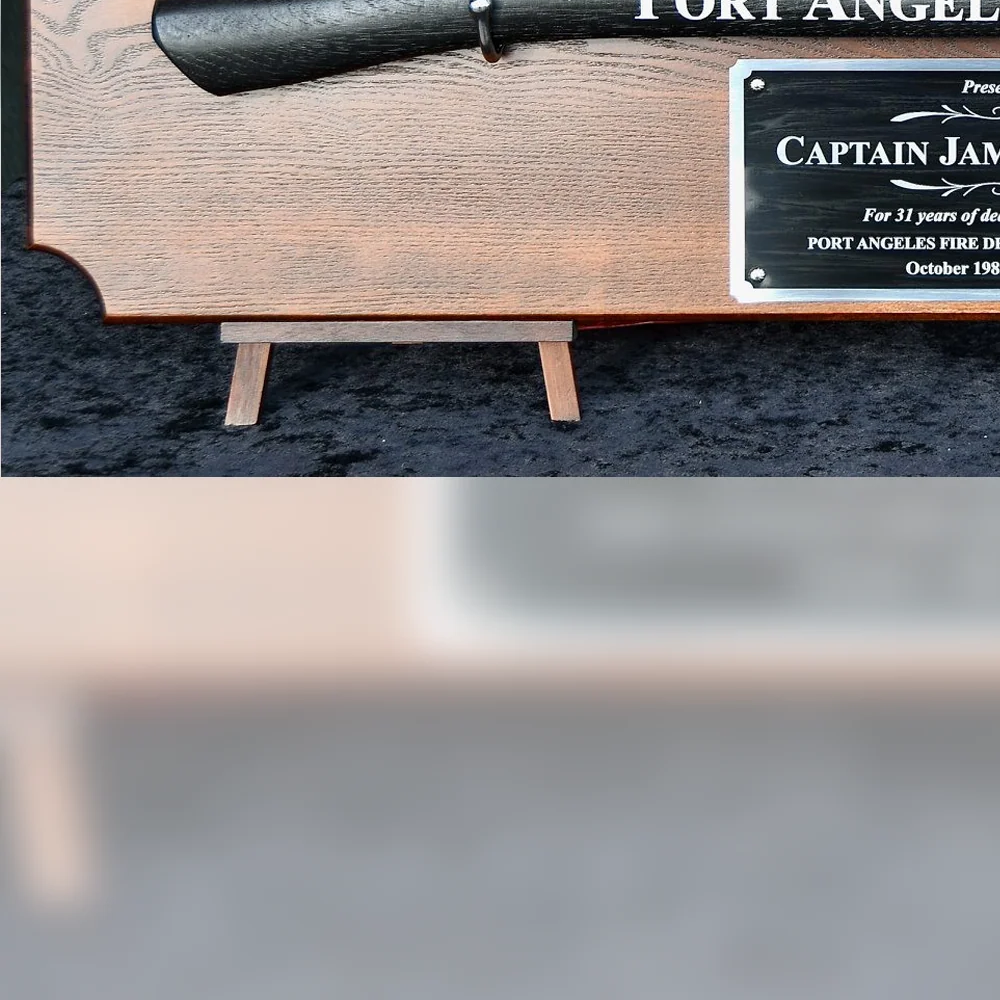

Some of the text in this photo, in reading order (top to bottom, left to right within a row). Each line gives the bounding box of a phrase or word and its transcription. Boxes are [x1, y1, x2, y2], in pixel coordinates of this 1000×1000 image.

[776, 135, 930, 166] CAPTAIN
[862, 208, 892, 223] For
[894, 208, 914, 223] 31
[915, 210, 958, 226] years
[960, 207, 981, 226] of
[807, 236, 855, 250] PORT
[856, 236, 936, 250] ANGELES
[939, 236, 980, 250] FIRE
[905, 260, 969, 276] October
